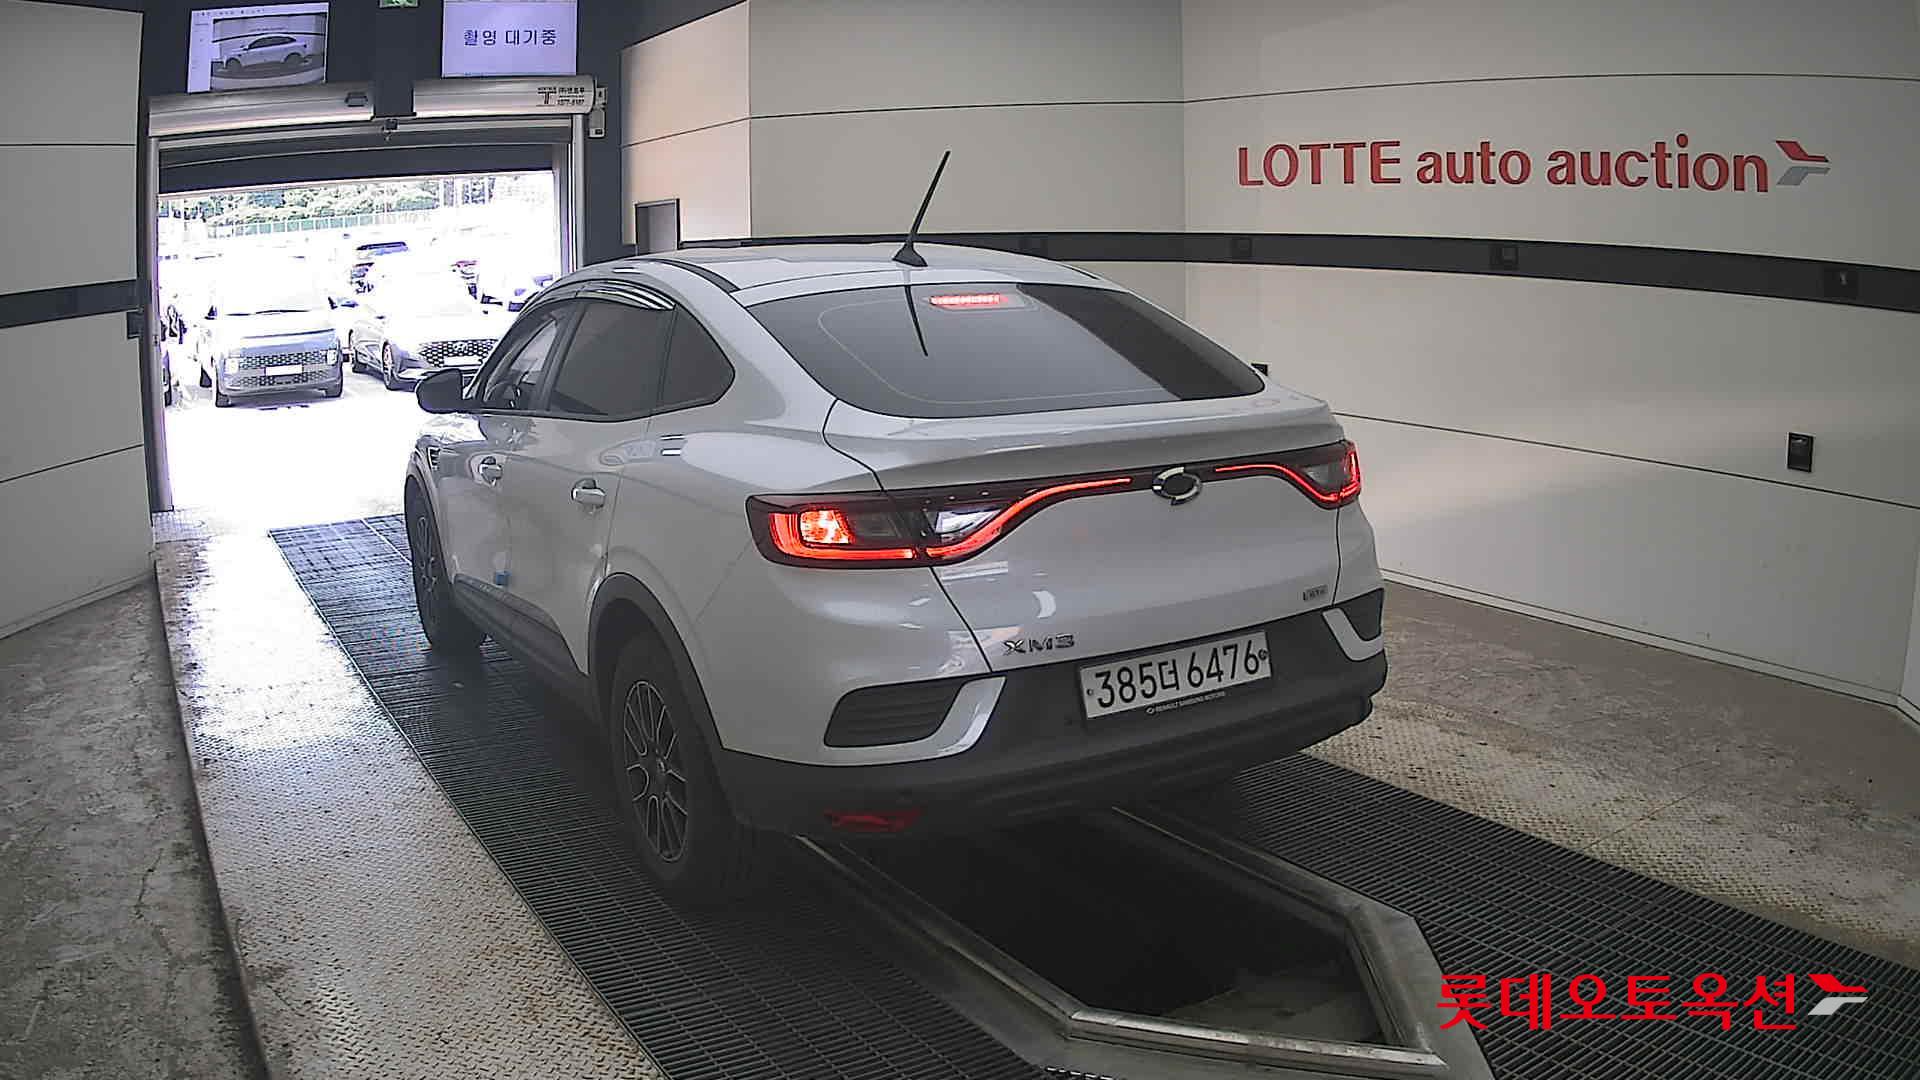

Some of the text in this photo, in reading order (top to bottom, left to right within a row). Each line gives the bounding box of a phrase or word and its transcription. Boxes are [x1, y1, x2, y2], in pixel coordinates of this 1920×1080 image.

[505, 29, 557, 46] 대기중
[1238, 133, 1769, 193] LOTTE auto auction
[1002, 633, 1076, 656] XM3
